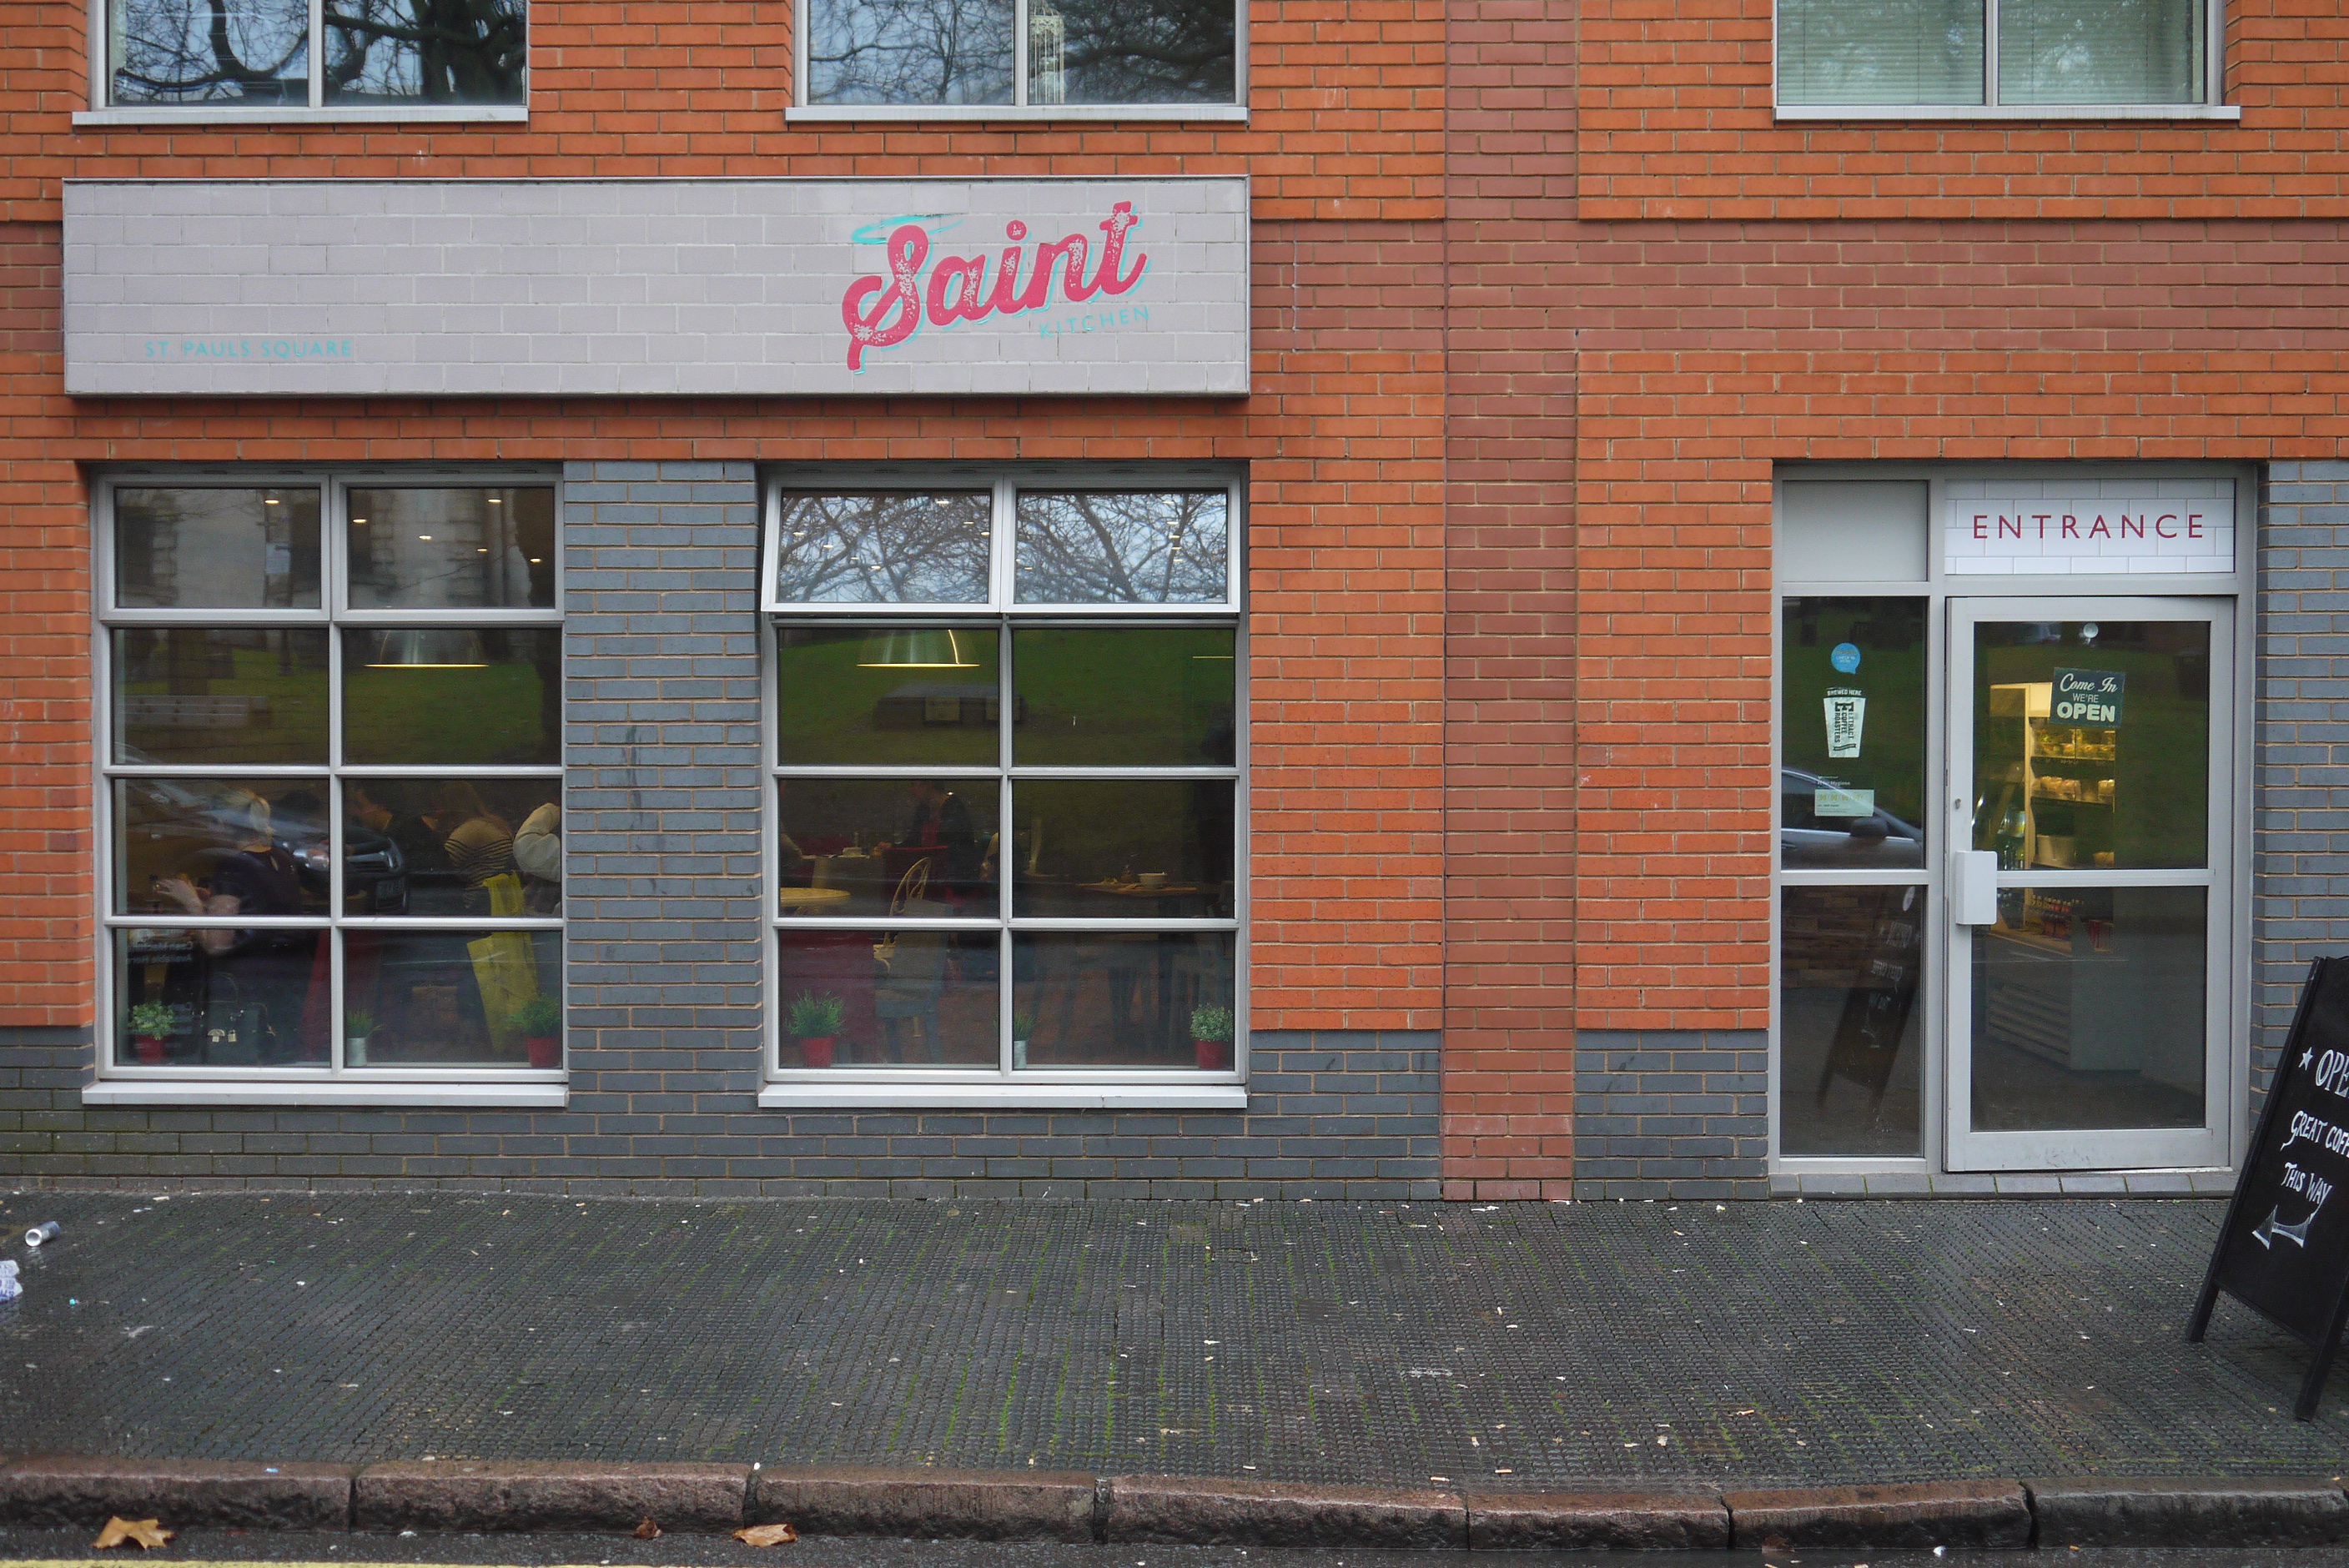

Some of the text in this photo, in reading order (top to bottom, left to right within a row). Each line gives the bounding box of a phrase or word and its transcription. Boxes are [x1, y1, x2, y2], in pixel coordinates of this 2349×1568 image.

[842, 200, 1149, 373] Saint
[1039, 305, 1150, 339] KITCHEN
[144, 340, 351, 359] ST. PAULS SQUARE
[1973, 514, 2204, 540] ENTRANCE
[2060, 672, 2118, 693] Come In
[2072, 692, 2099, 703] WE'RE
[2056, 701, 2115, 722] OPEN
[2316, 1049, 2349, 1098] OPE
[2280, 1110, 2349, 1158] GREAT COFF
[2281, 1162, 2332, 1223] THIS WAY
